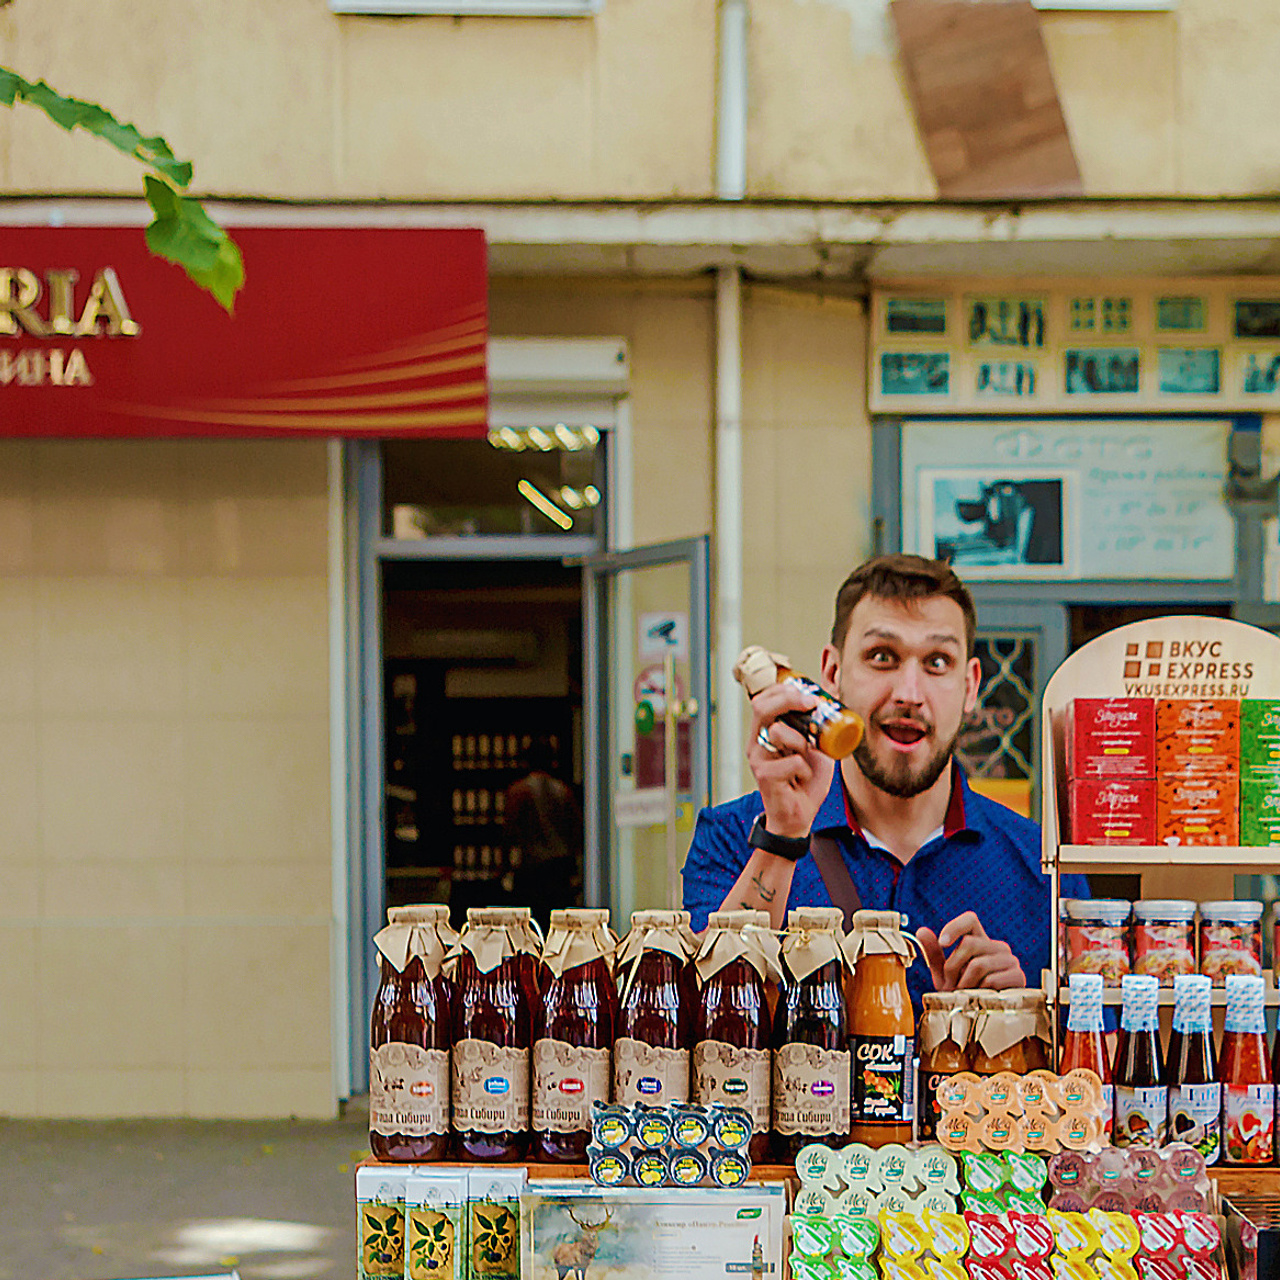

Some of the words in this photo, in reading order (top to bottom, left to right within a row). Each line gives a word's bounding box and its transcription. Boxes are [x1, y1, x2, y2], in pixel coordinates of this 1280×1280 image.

[1169, 641, 1222, 658] ВКУС
[1167, 662, 1254, 680] EXPRESS
[1124, 683, 1250, 697] VKUSEXPRESS.RU
[857, 1043, 895, 1061] СОК
